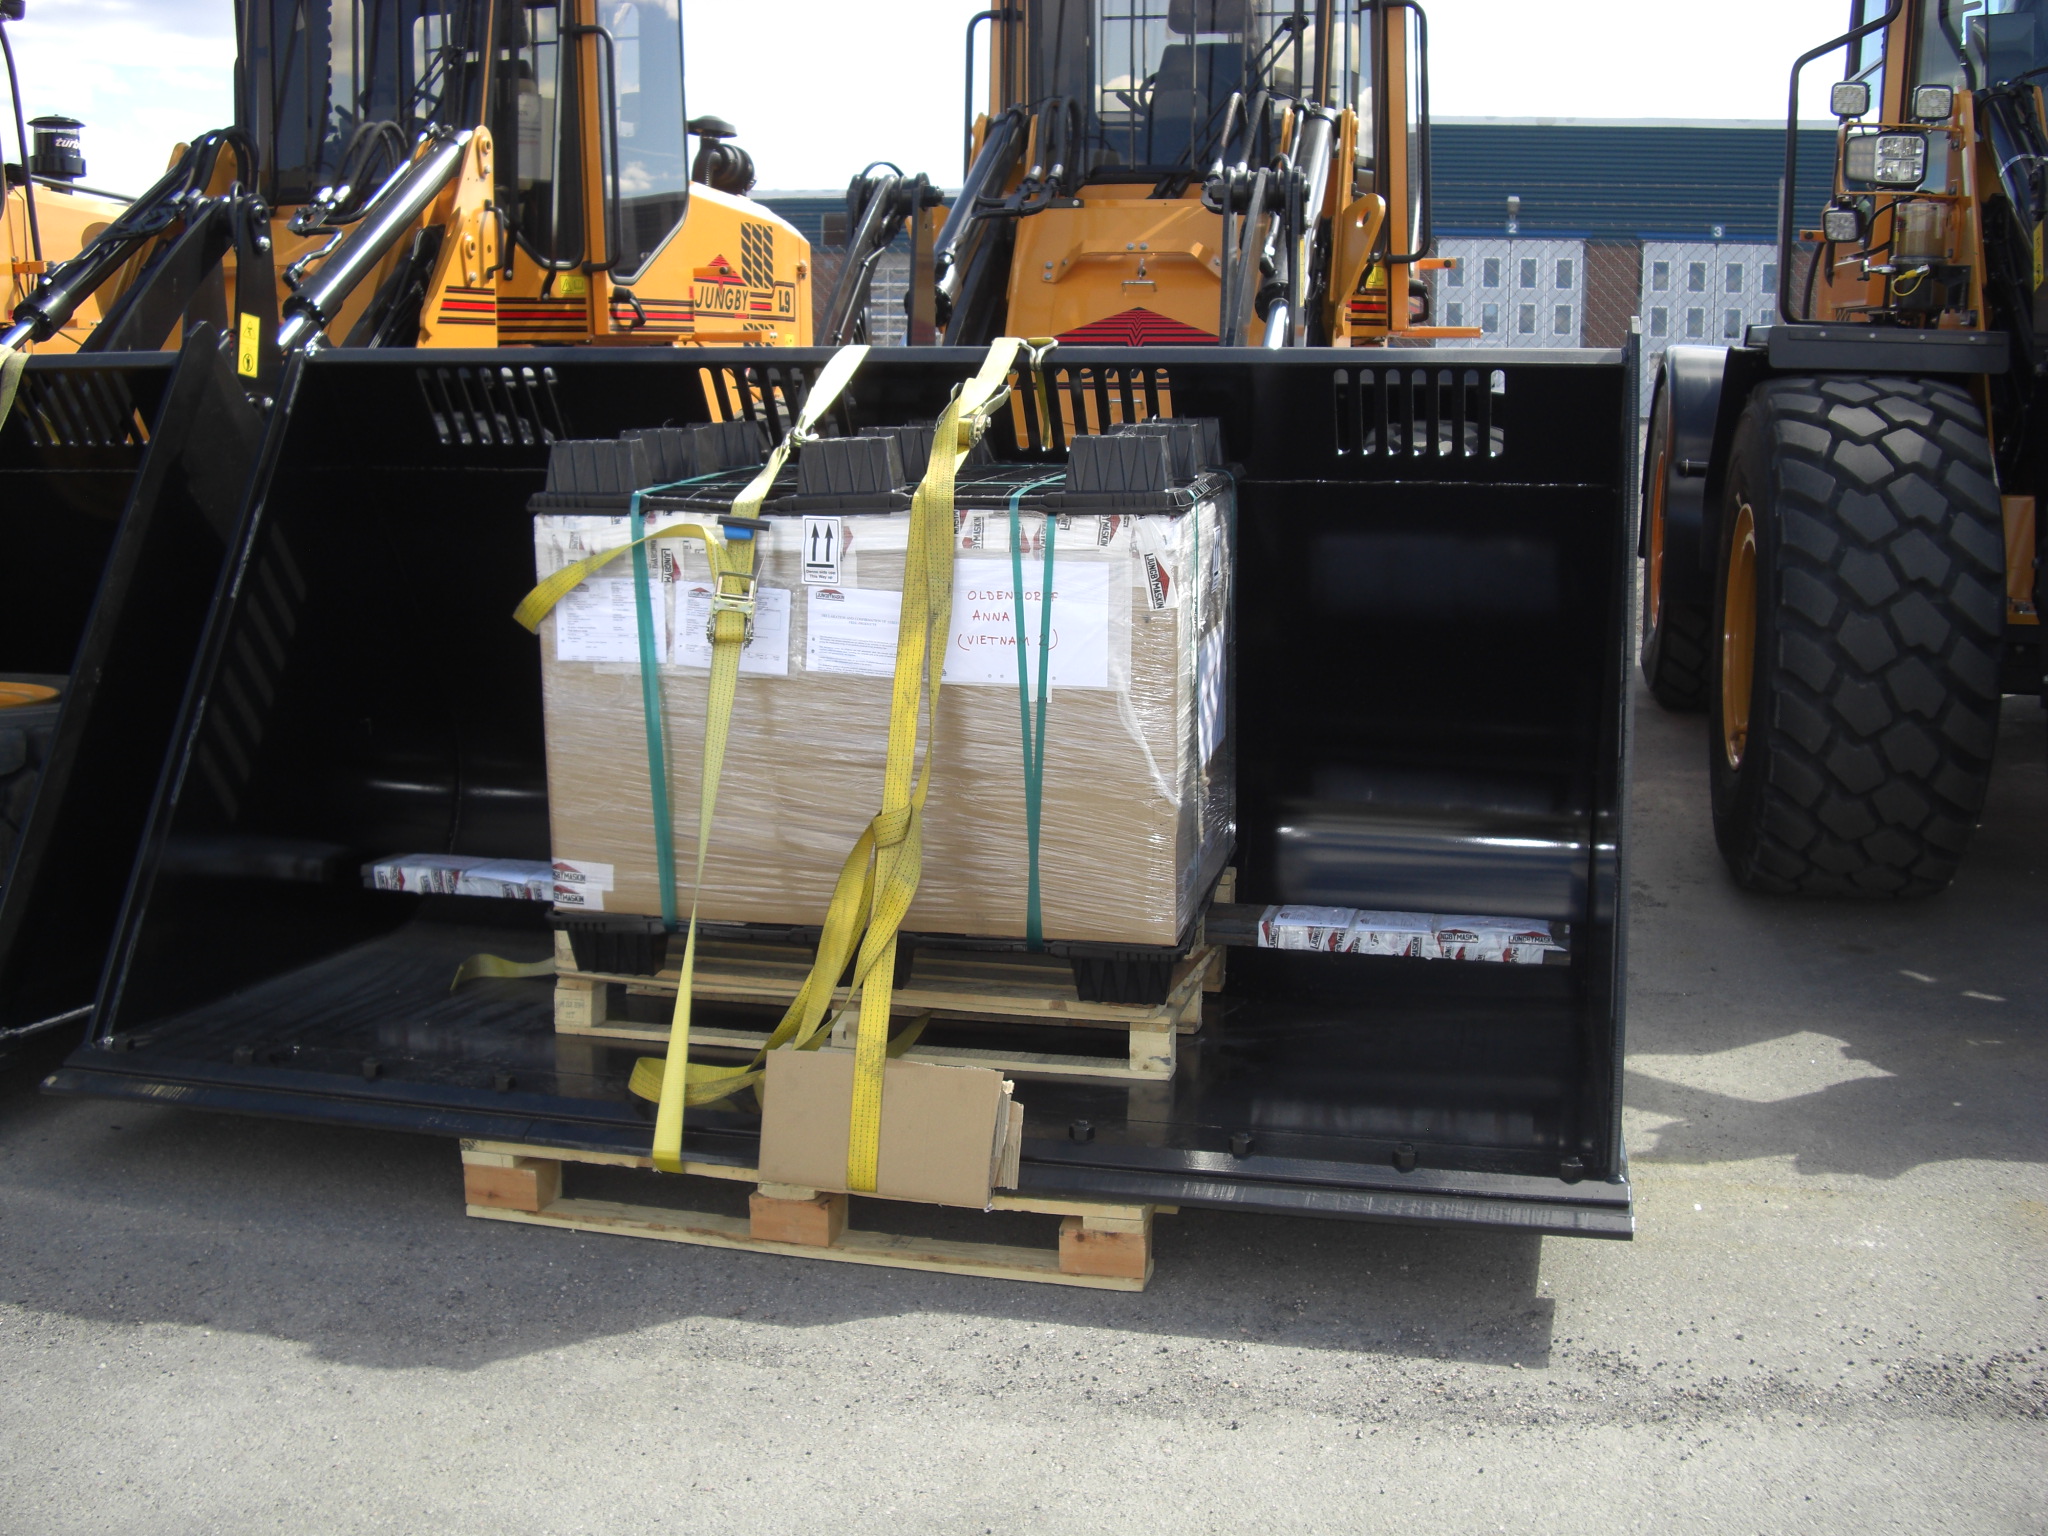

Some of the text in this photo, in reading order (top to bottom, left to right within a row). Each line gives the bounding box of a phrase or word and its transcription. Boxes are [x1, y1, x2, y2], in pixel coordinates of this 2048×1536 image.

[1508, 224, 1517, 233] 2
[1714, 226, 1723, 237] 3
[778, 289, 791, 313] L9
[972, 610, 1010, 622] ANNA
